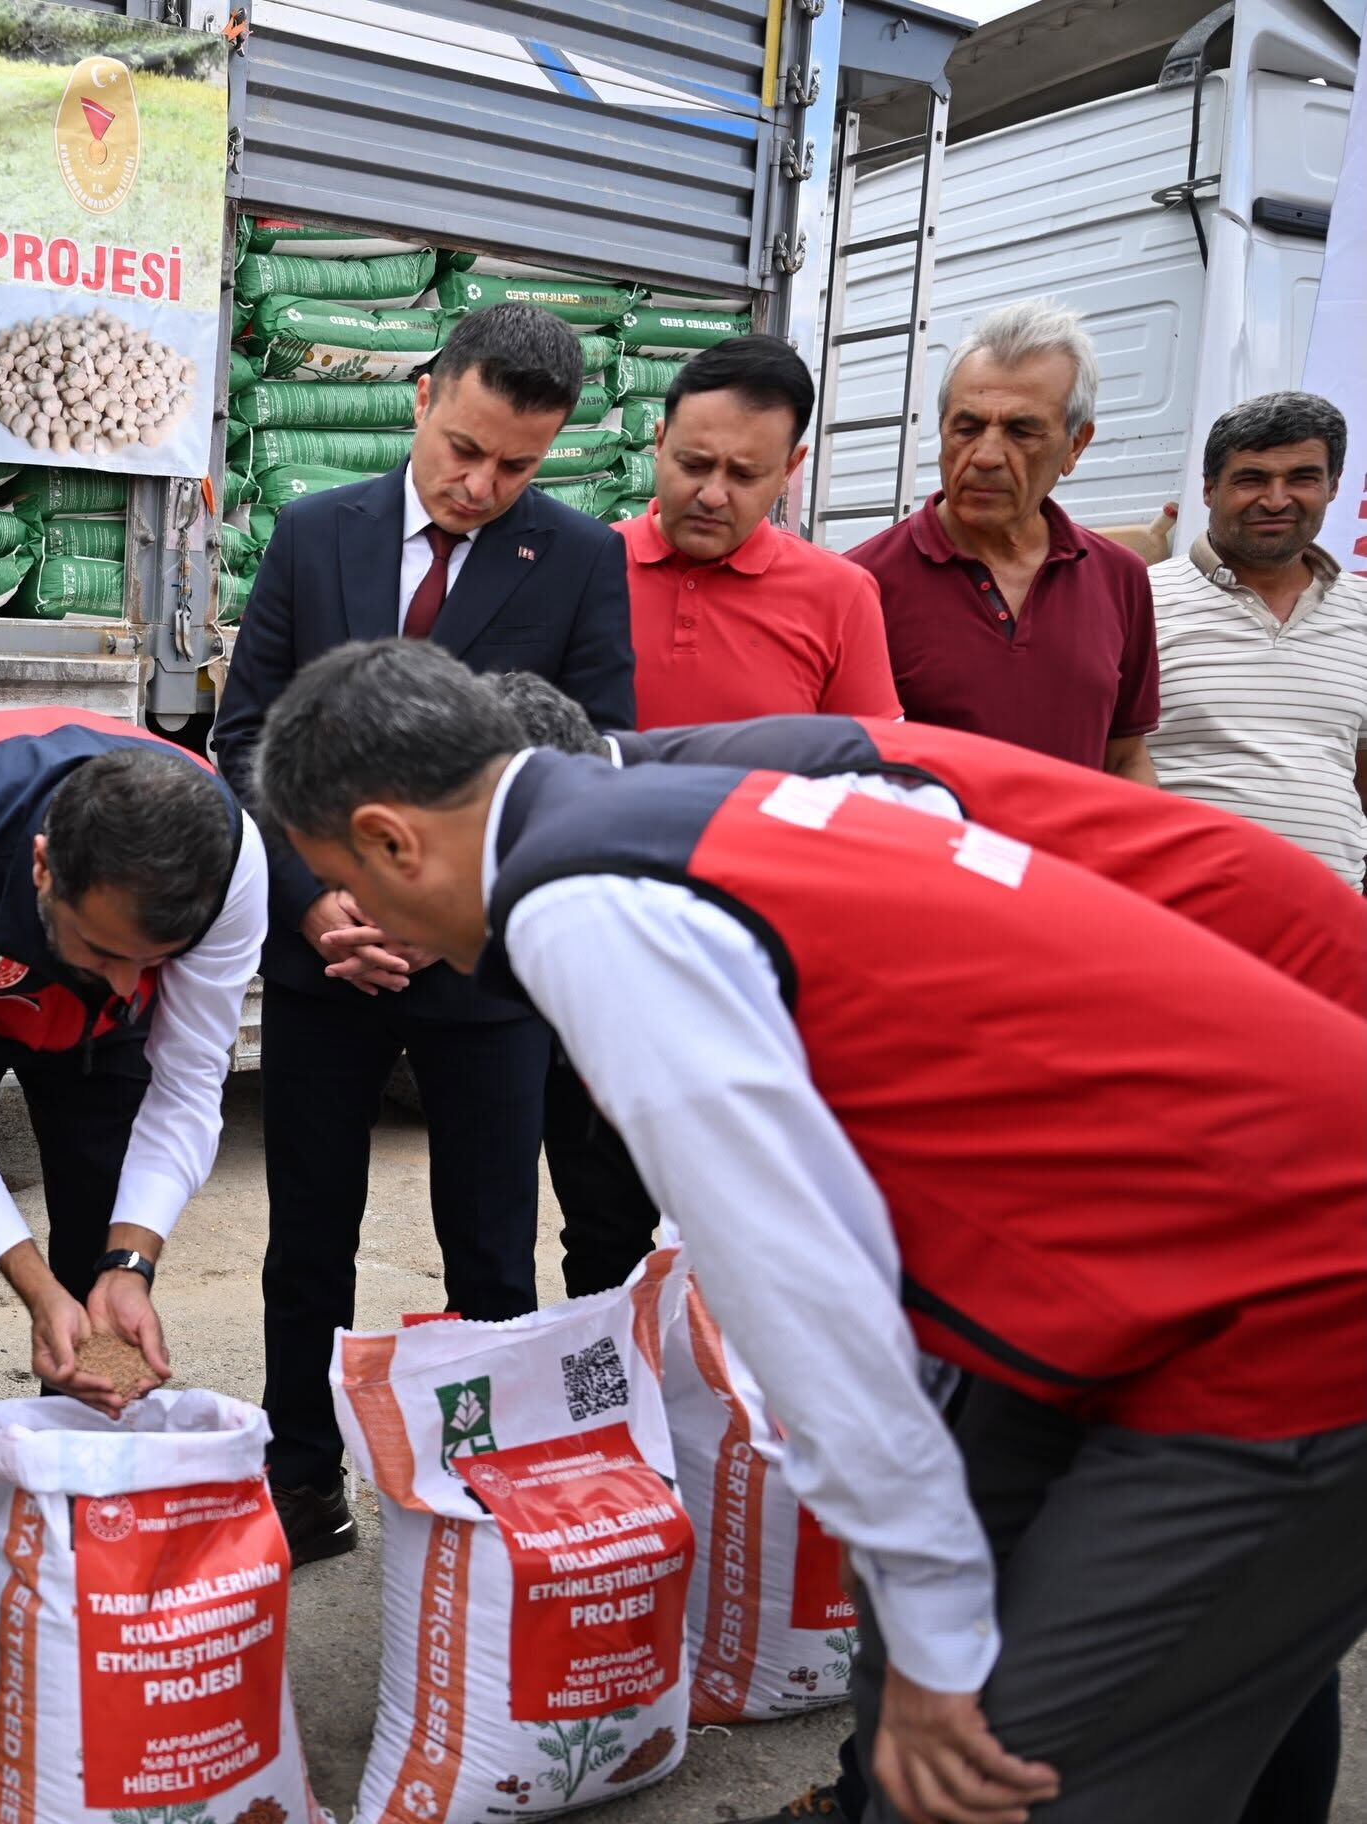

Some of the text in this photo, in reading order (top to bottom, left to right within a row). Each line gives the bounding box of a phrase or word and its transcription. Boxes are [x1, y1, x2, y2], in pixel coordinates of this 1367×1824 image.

[506, 290, 530, 300] SEED
[532, 291, 580, 303] CERTIFIED
[330, 315, 359, 326] SEED
[660, 317, 684, 328] SEED
[686, 319, 732, 331] CERTIFIED
[88, 1561, 282, 1617] TARIM ARAZİLERİNİN
[121, 1599, 258, 1646] KULLANIMININ
[570, 1586, 655, 1628] PROJESİ
[96, 1613, 274, 1672] ETKİNLEŞTİRİLMESİ
[718, 1600, 743, 1665] SEED
[144, 1657, 243, 1706] PROJESİ
[547, 1686, 611, 1709] HİBELİ
[146, 1718, 244, 1753] KAPSAMINDA
[177, 1732, 248, 1767] BAKANLIK
[122, 1742, 261, 1795] HİBELİ TOHUM
